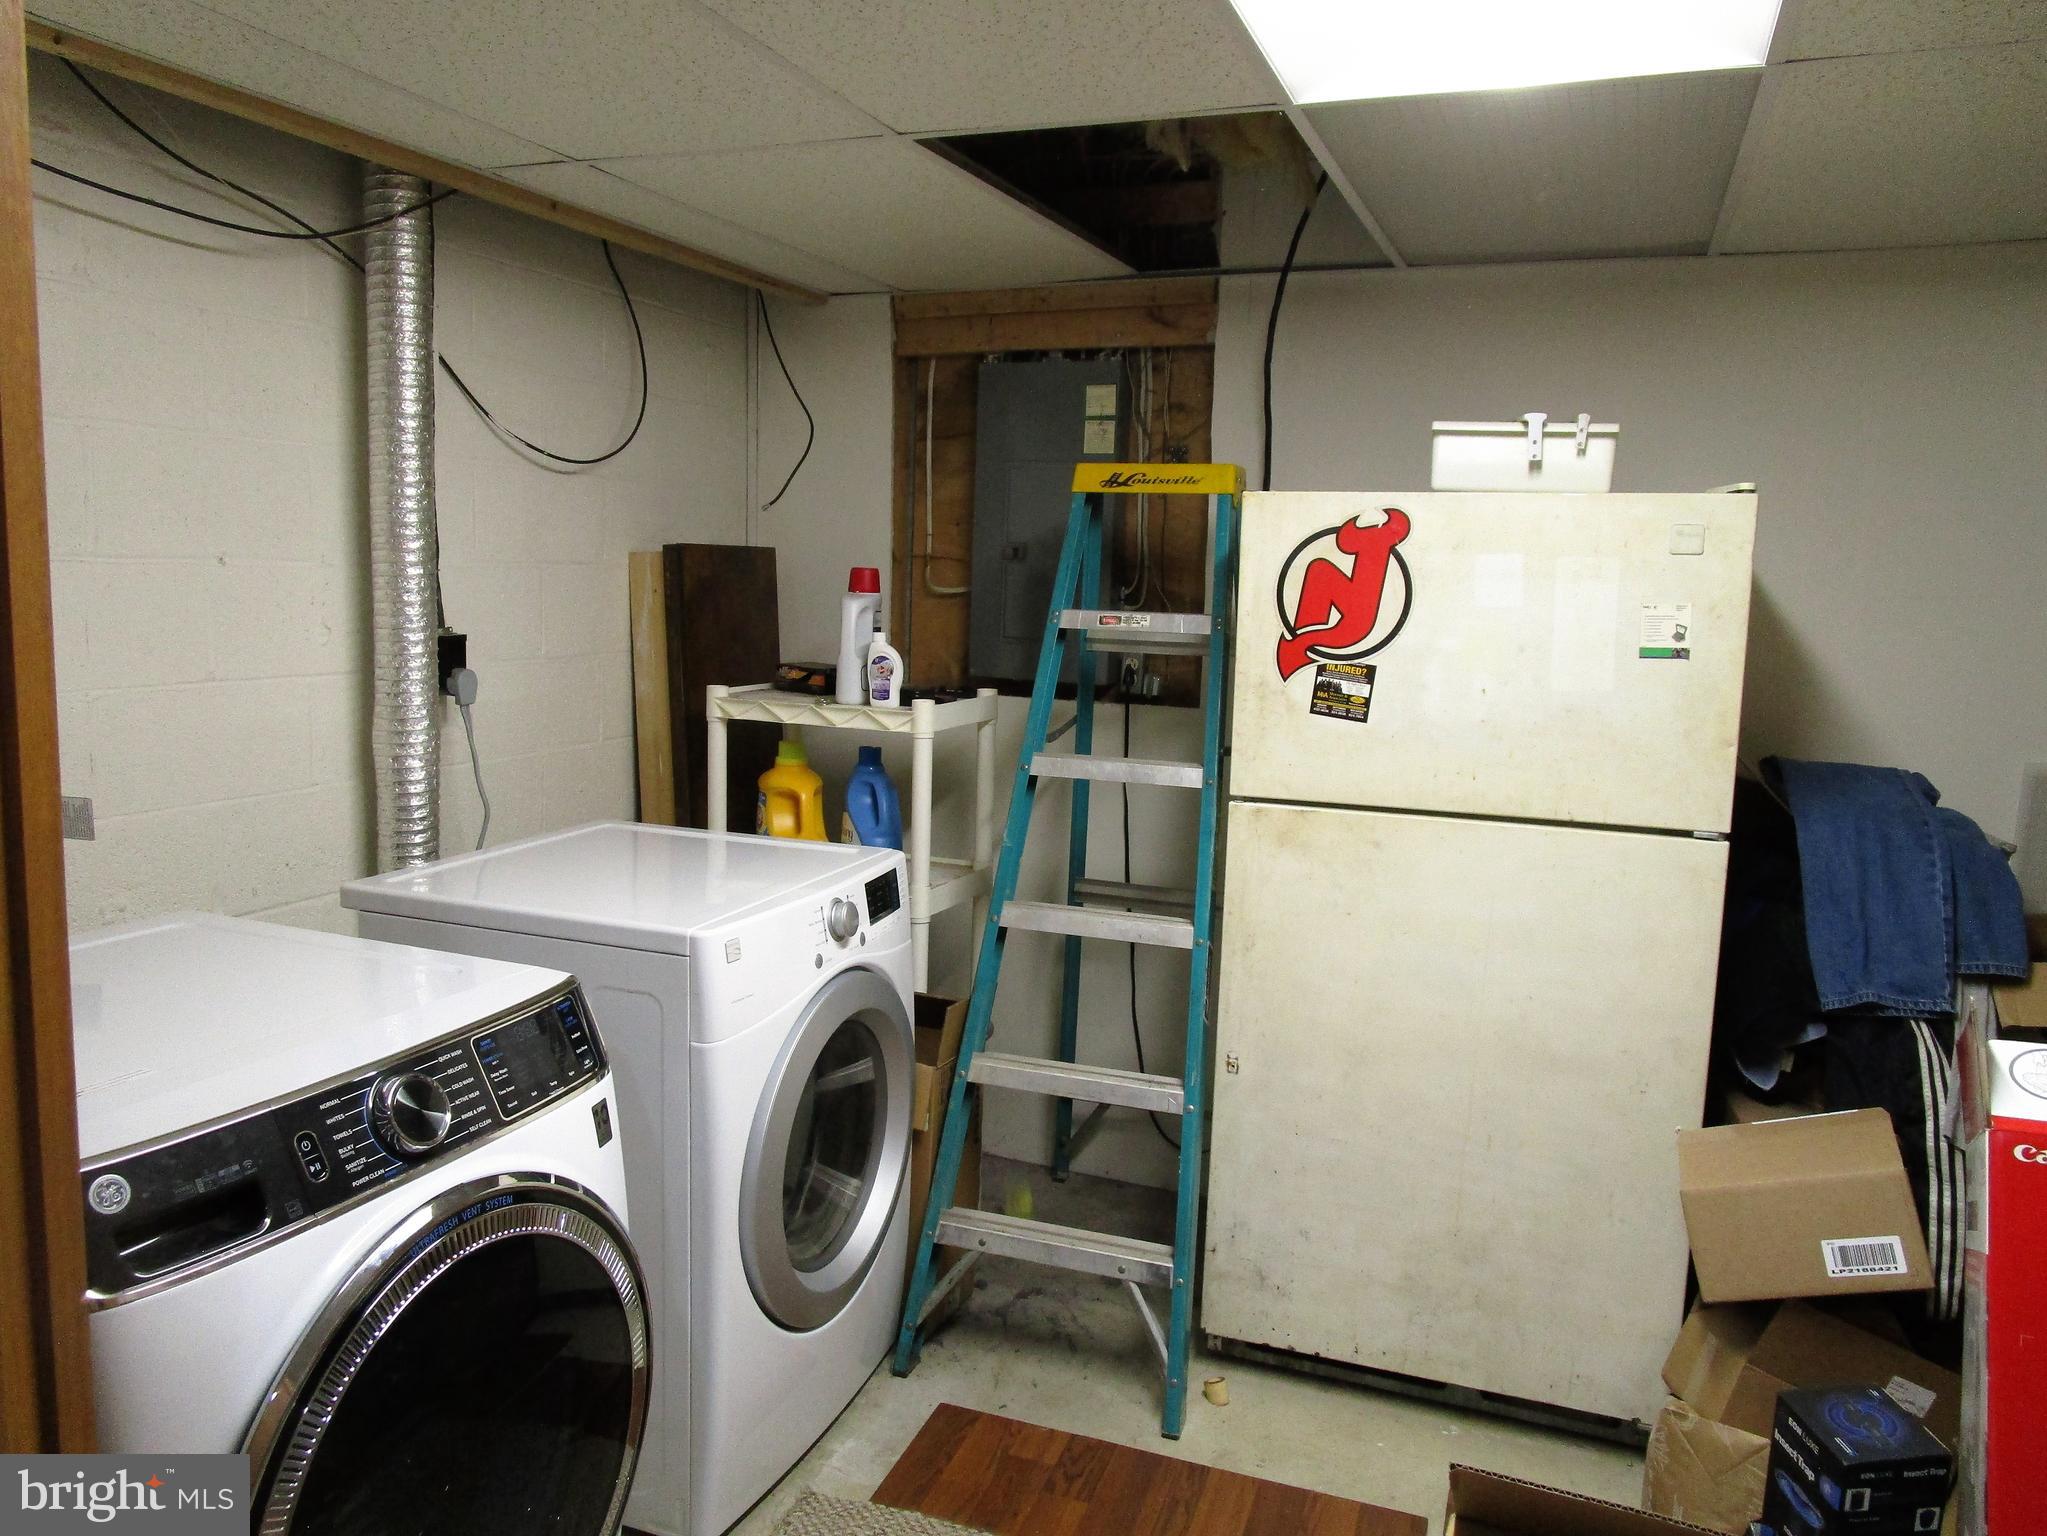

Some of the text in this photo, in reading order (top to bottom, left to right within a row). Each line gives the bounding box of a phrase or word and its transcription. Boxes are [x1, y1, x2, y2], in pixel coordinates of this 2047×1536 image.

[1099, 472, 1204, 488] Louisville
[1326, 664, 1367, 676] INJURED?
[451, 1049, 463, 1057] WASH
[447, 1062, 468, 1075] DELICATES
[451, 1076, 475, 1090] COLD WASH
[319, 1098, 341, 1111] NORMAL
[326, 1113, 345, 1125] WHITES
[332, 1128, 353, 1141] TOWELS
[338, 1143, 354, 1155] BULKY
[345, 1156, 367, 1170] SANITIZE
[352, 1174, 369, 1188] POWER
[368, 1168, 385, 1180] CLEAN
[410, 1195, 514, 1258] ULTRAFRESH VENT SYSTEM
